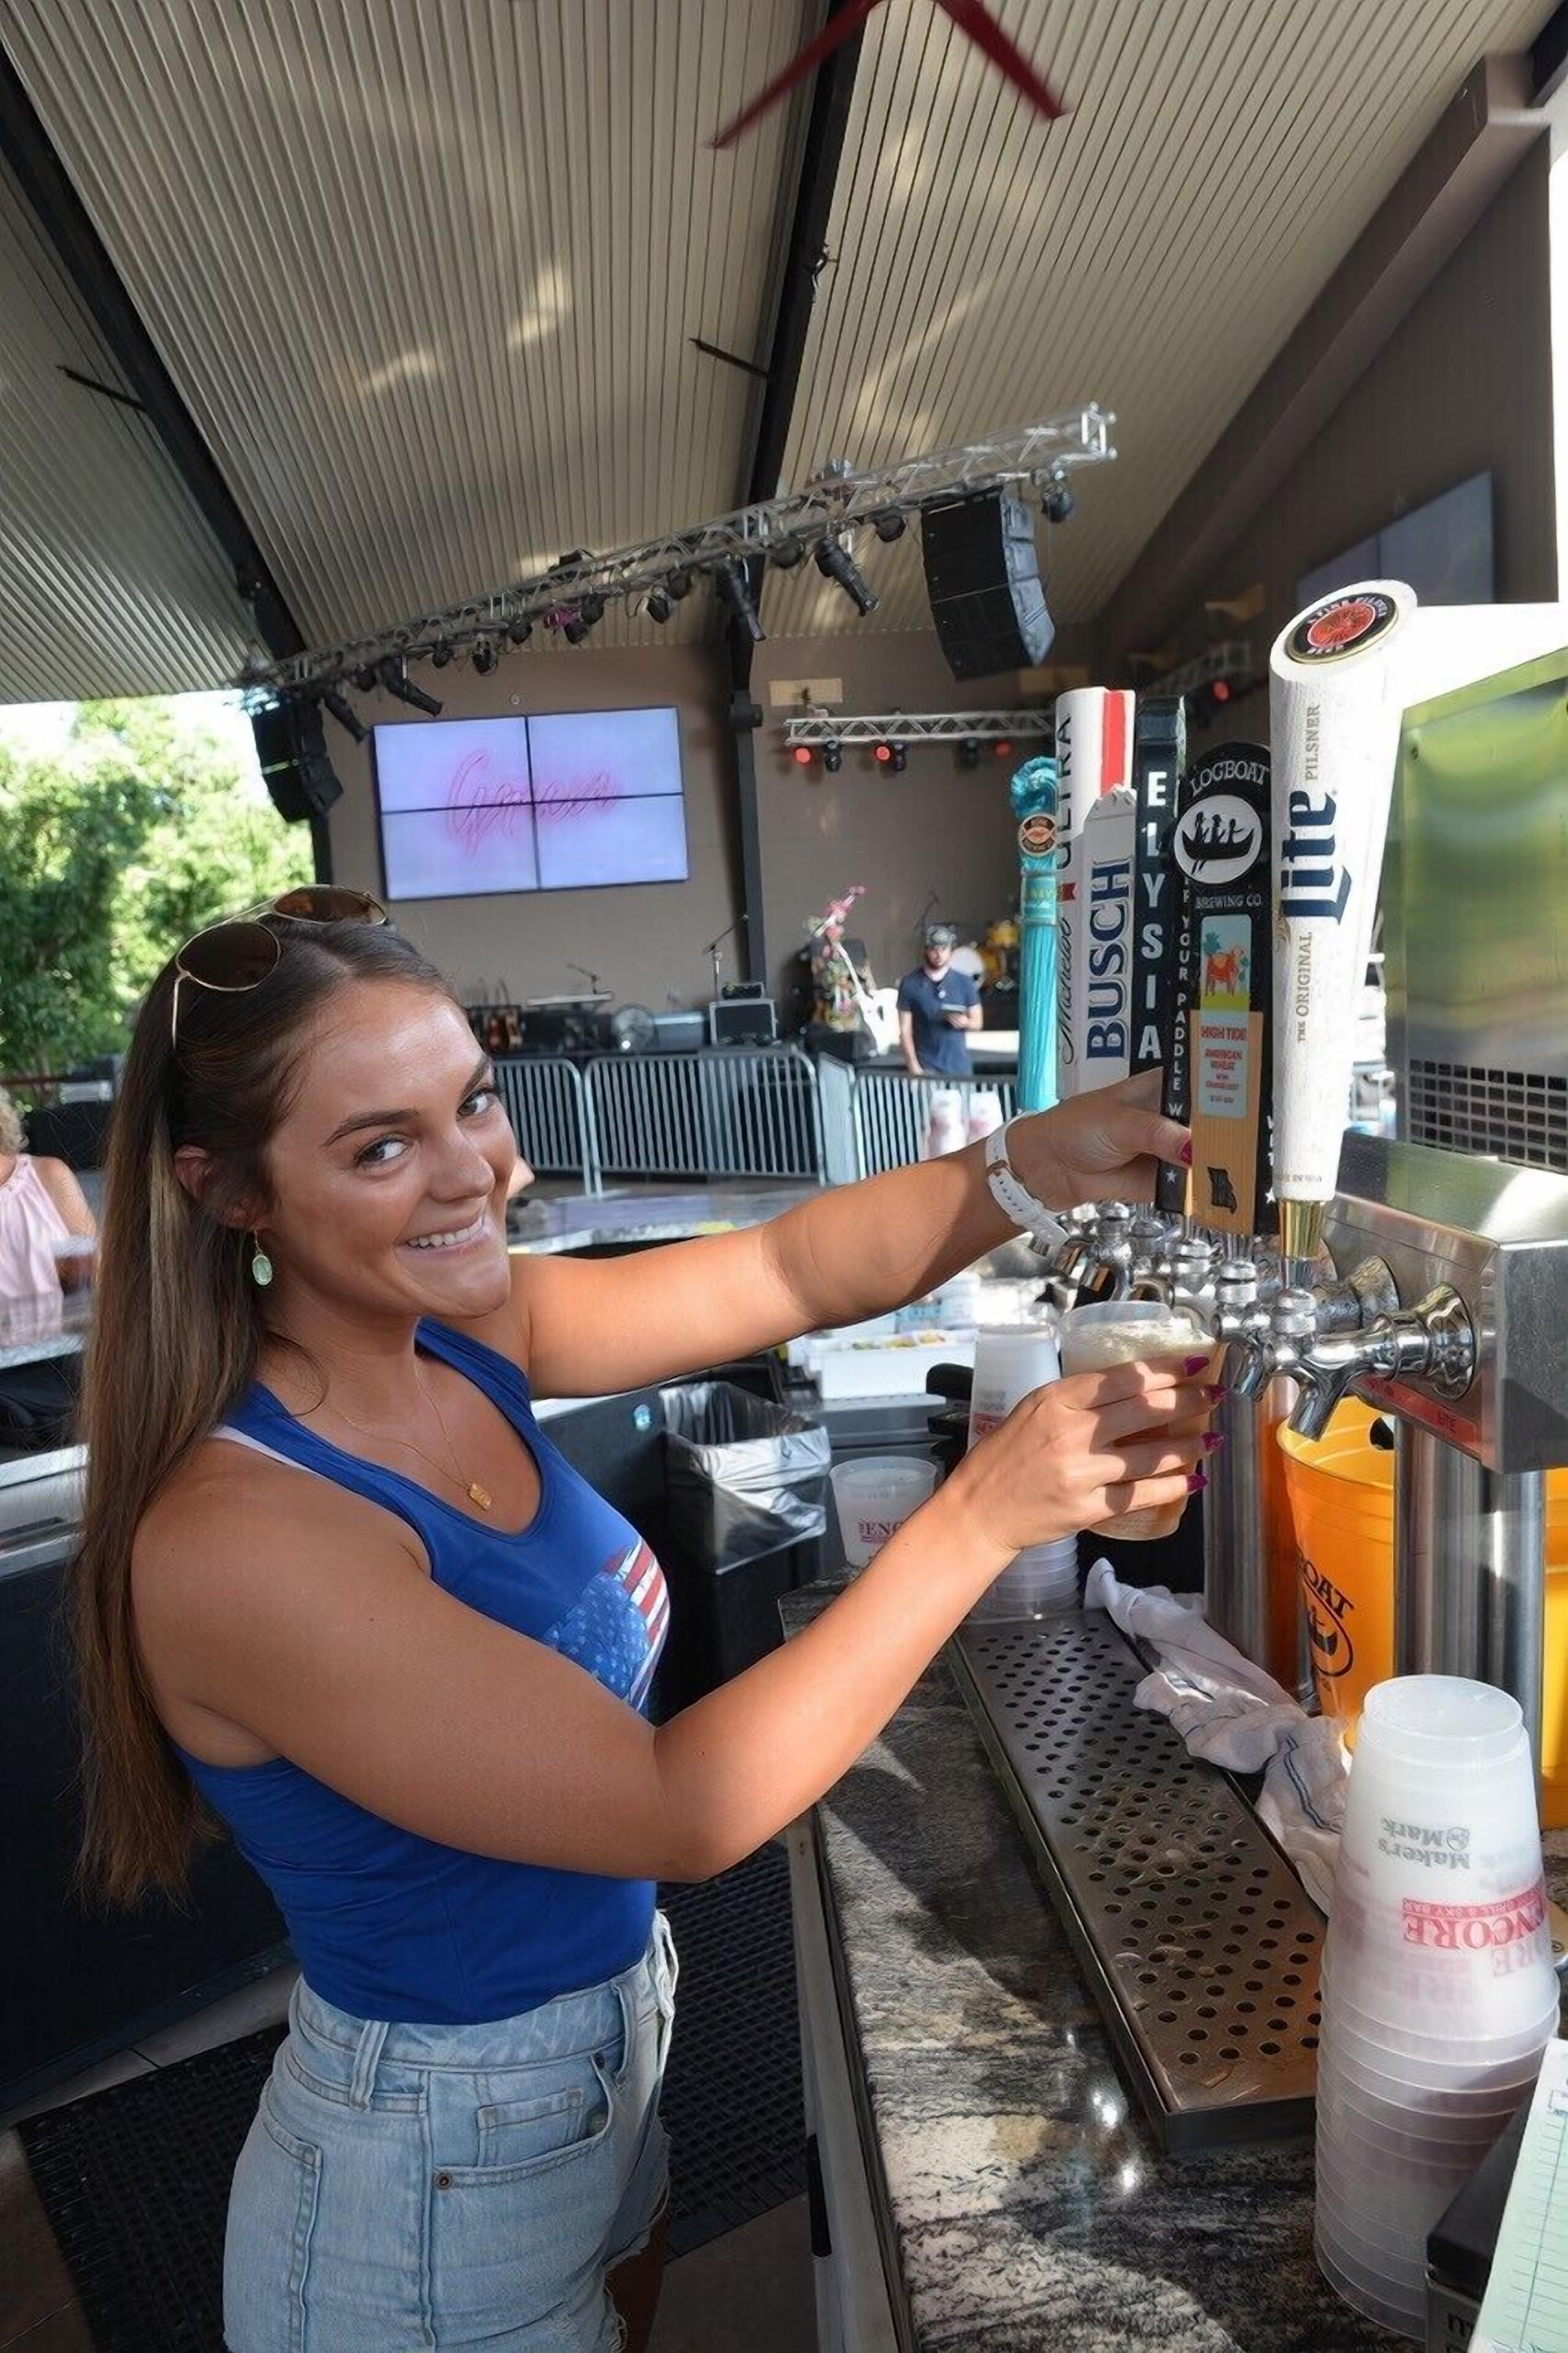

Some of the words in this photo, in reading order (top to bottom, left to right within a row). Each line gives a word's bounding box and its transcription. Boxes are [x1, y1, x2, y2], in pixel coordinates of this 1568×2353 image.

[1191, 760, 1269, 797] LOGBOAT
[1305, 705, 1321, 780] PILSNER
[1281, 790, 1352, 925] Lite
[1086, 862, 1131, 1059] BUSCH
[1295, 932, 1312, 1017] ORIGINAL
[1381, 1817, 1443, 1847] Mark
